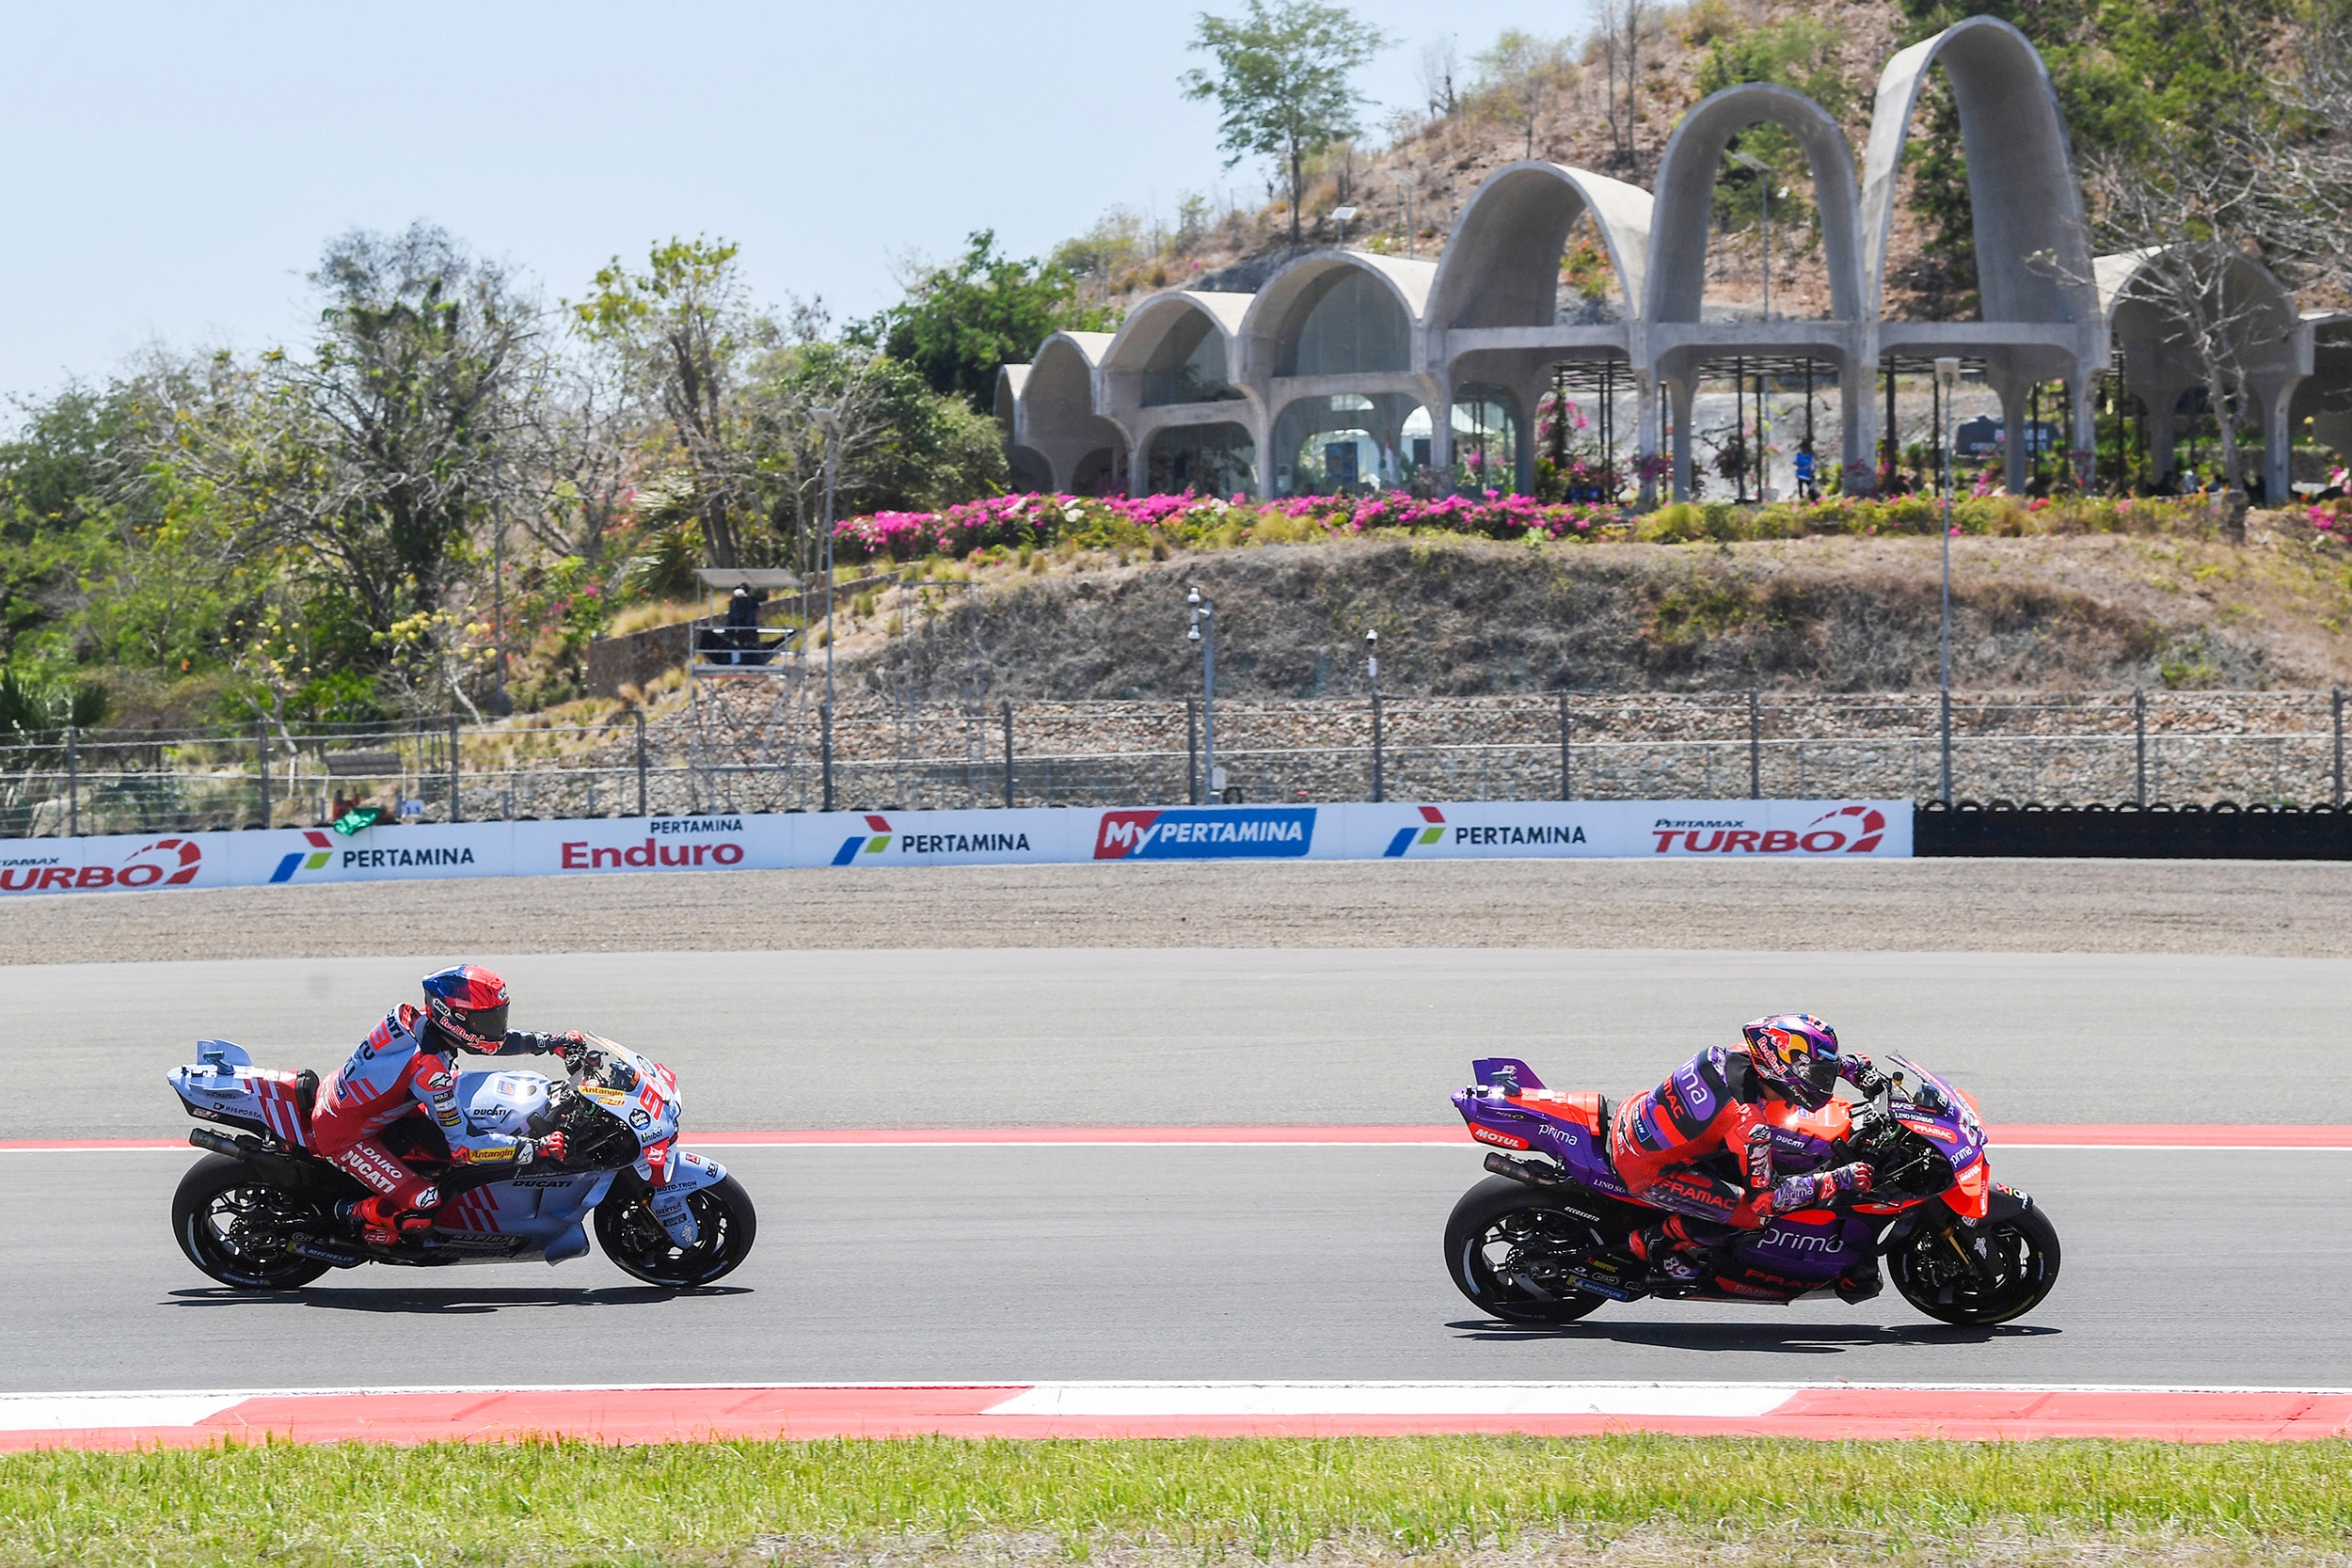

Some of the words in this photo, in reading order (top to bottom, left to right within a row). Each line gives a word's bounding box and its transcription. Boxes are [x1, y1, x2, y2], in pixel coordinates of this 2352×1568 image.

[650, 818, 743, 834] PERTAMINA
[1655, 818, 1744, 830] PERTAMAX
[901, 832, 1030, 853] PERTAMINA
[1455, 825, 1586, 845] PERTAMINA
[1651, 829, 1847, 853] TURBO
[342, 846, 474, 868] PERTAMINA
[561, 836, 745, 869] Enduro
[434, 999, 450, 1015] SHOEI
[580, 1086, 625, 1098] Antangin
[472, 1108, 508, 1117] DUCATI
[1474, 1128, 1519, 1148] MOTUL
[1537, 1123, 1579, 1147] prima
[1912, 1124, 1953, 1140] PRAMAC
[1775, 1134, 1805, 1149] DUCATI
[470, 1148, 515, 1160] Antangin
[1949, 1146, 1974, 1168] prima
[340, 1149, 396, 1195] DUCATI
[1593, 1179, 1613, 1192] LINO
[1756, 1227, 1844, 1254] prima
[308, 1248, 356, 1262] MICHELIN
[1583, 1282, 1624, 1299] MICHELIN
